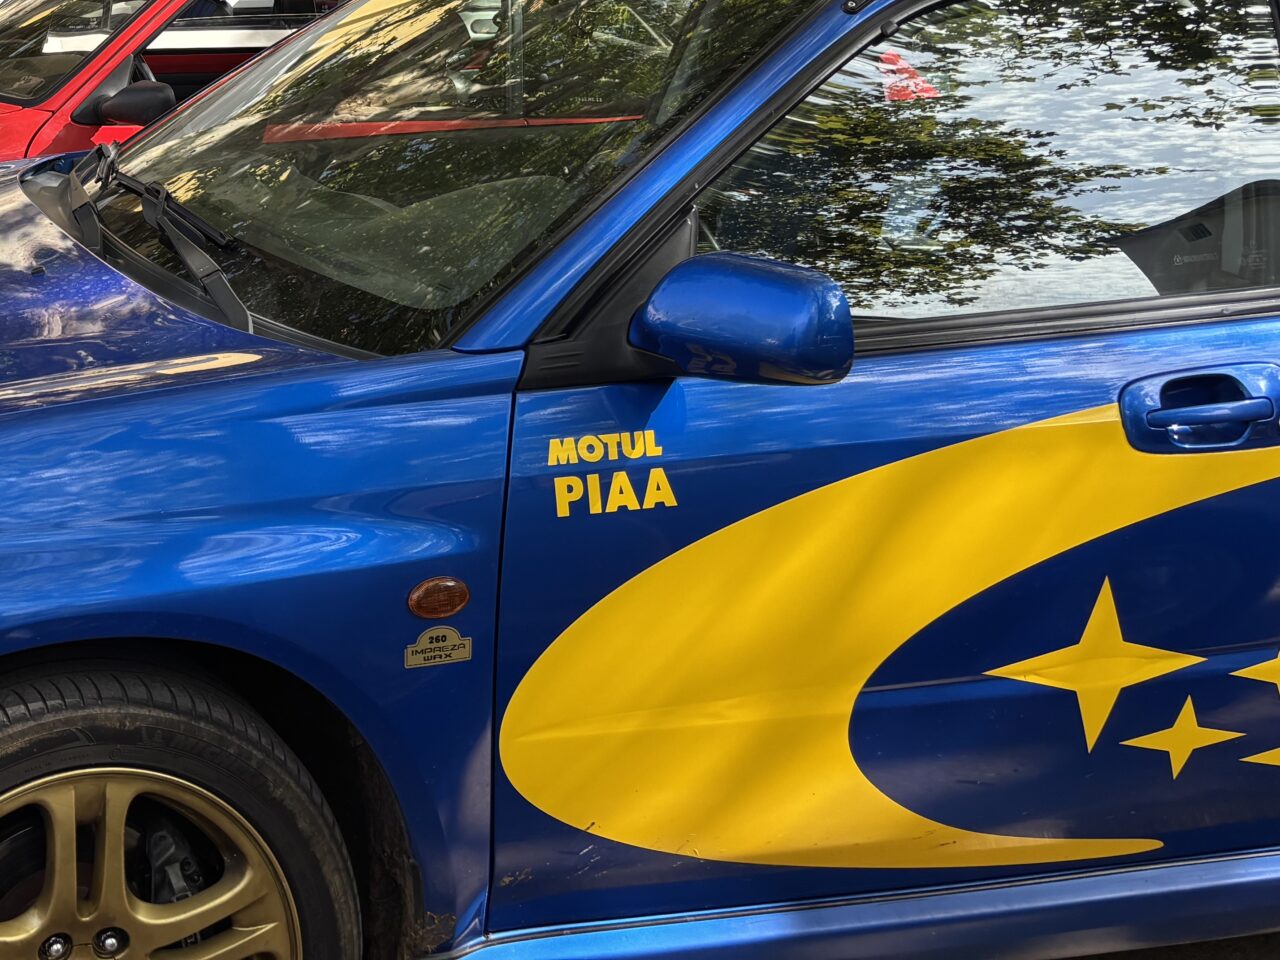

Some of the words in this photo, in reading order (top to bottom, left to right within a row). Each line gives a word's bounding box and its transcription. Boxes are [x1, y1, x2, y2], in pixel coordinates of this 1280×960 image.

[548, 430, 663, 466] MOTUL
[554, 467, 678, 518] PIAA
[428, 634, 447, 644] 260
[411, 642, 466, 657] IMPREZA
[423, 652, 453, 662] WRX
